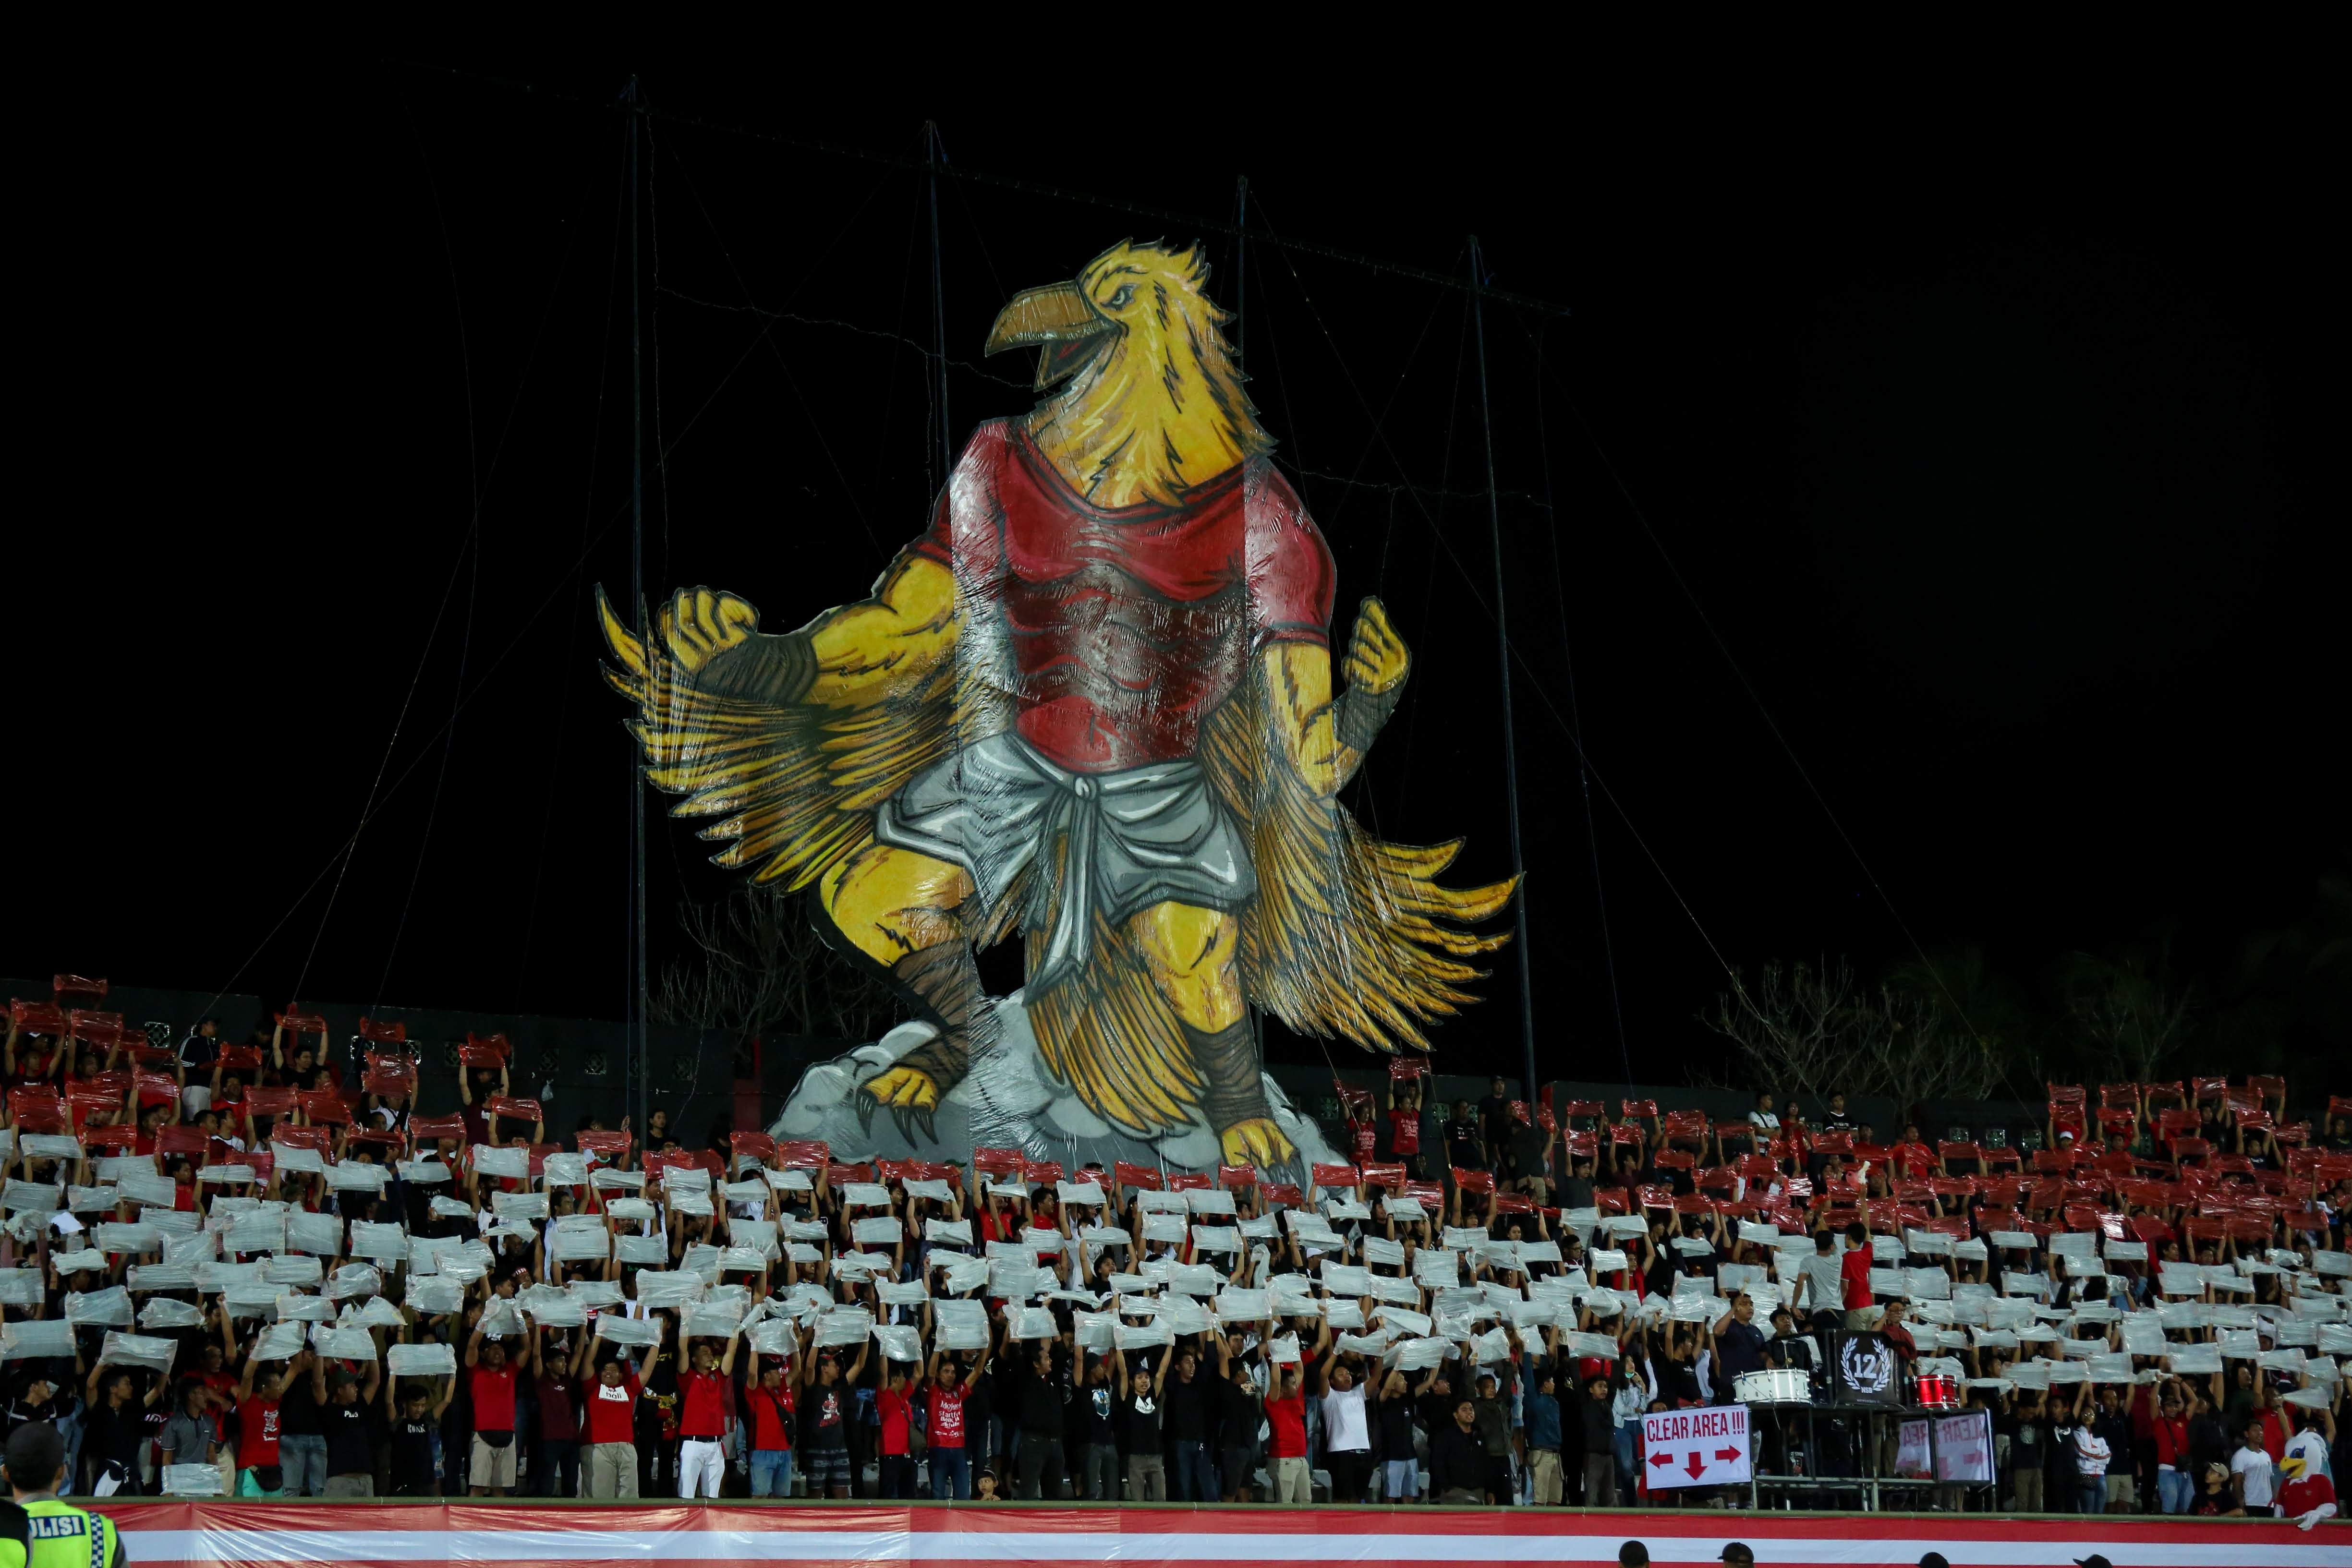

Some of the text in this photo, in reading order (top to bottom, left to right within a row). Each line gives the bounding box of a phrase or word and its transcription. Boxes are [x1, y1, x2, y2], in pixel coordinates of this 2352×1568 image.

[1854, 1353, 1877, 1379] 12
[1647, 1411, 1745, 1442] CLEAR AREA !!!
[29, 1517, 82, 1537] OLISI
